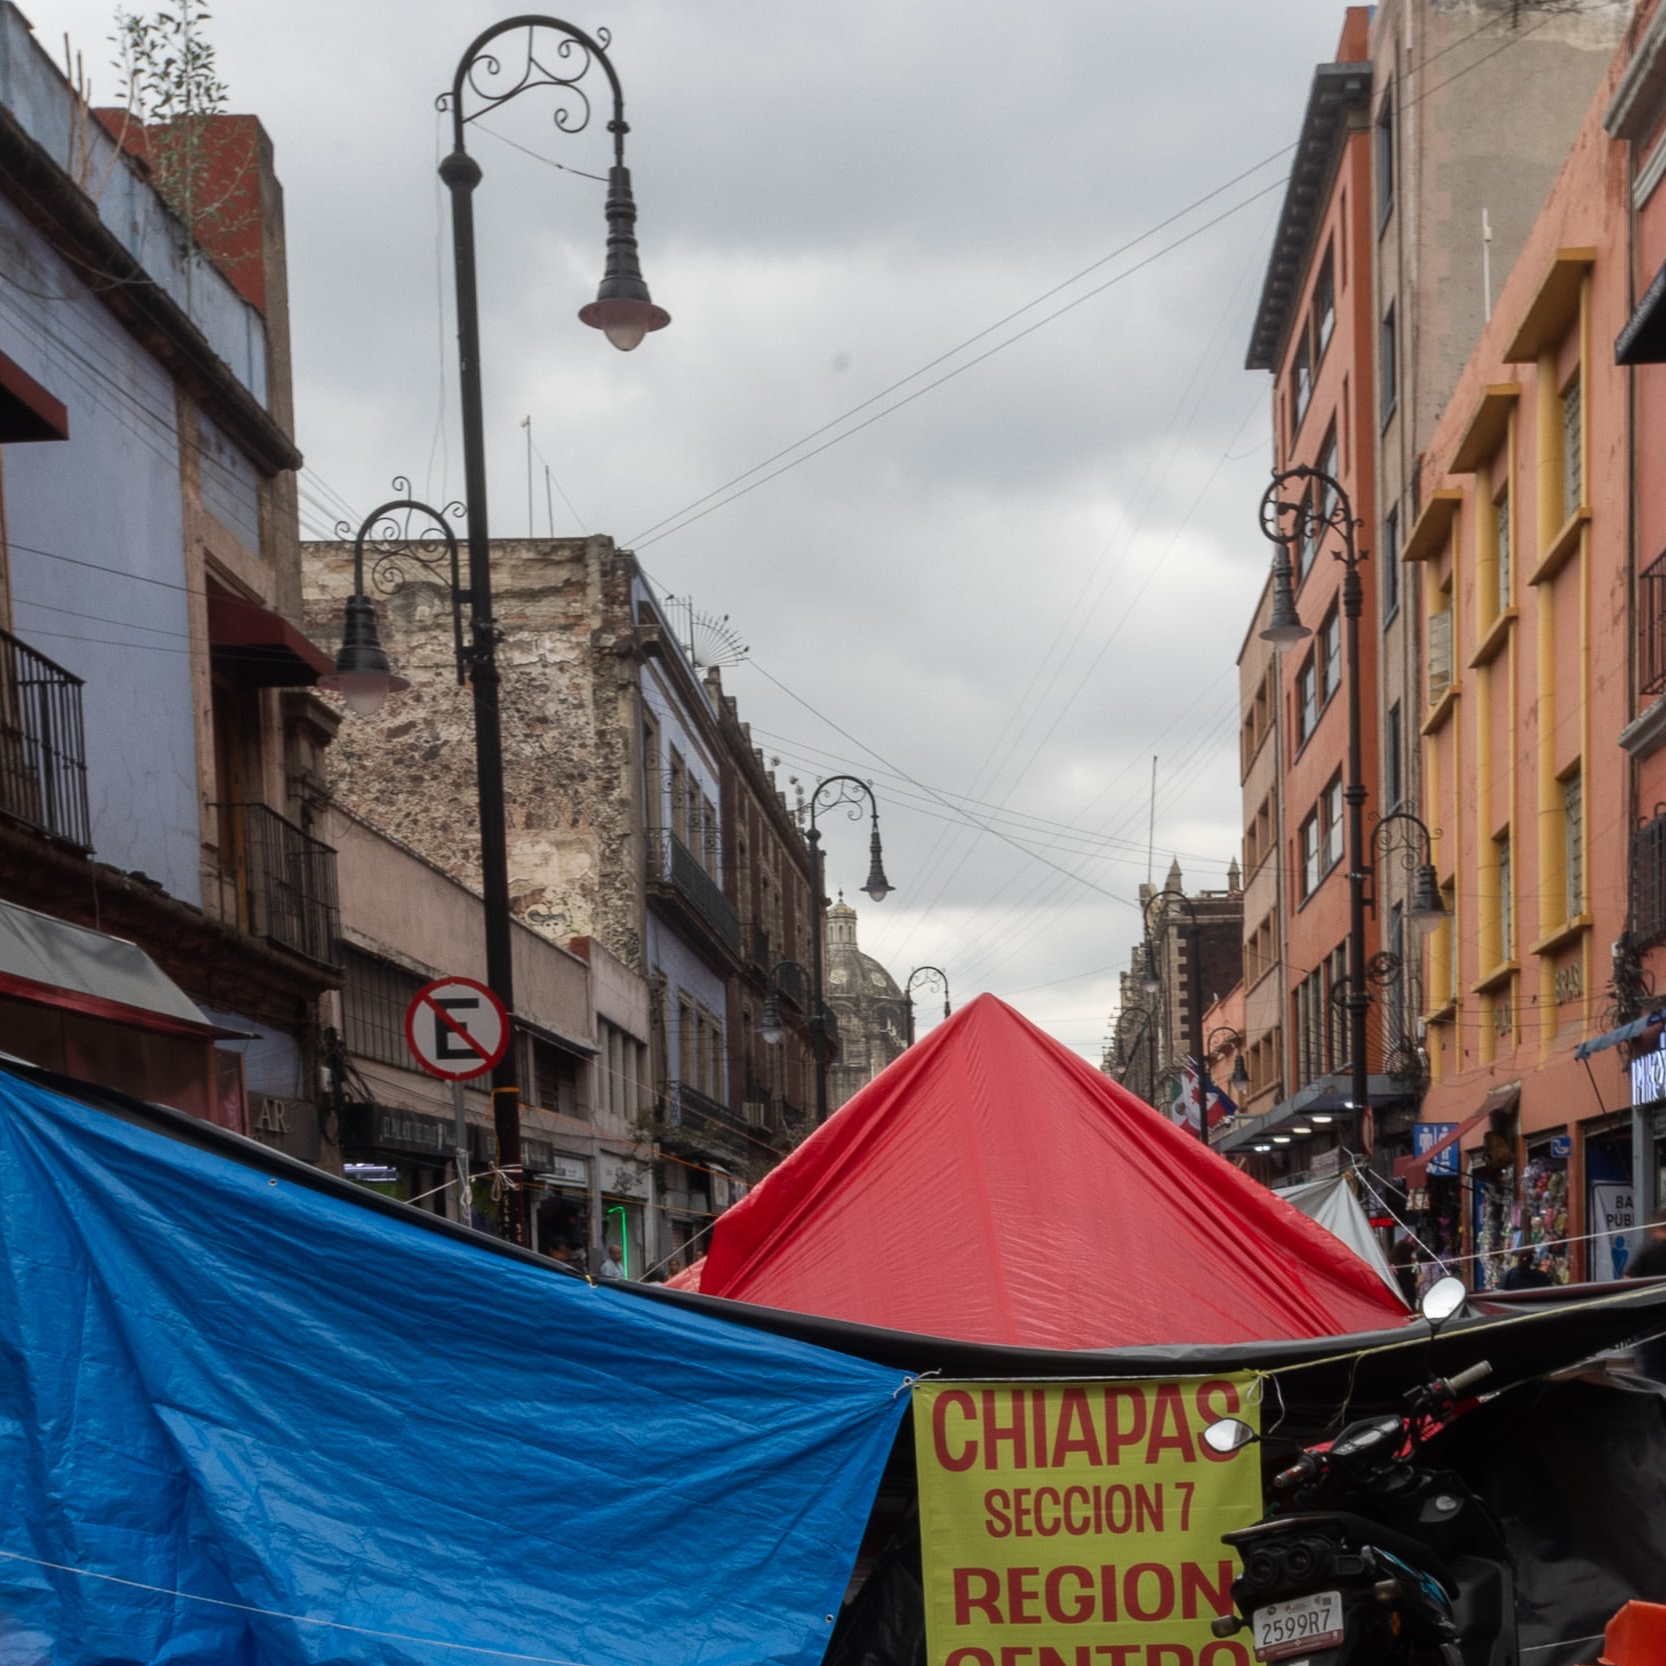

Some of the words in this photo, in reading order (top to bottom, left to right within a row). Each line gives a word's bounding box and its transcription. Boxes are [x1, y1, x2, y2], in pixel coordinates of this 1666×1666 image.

[932, 1380, 1240, 1473] CHIAPAS
[984, 1483, 1165, 1539] SECCION
[1174, 1481, 1196, 1532] 7
[952, 1559, 1234, 1626] REGION
[1261, 1607, 1331, 1646] 2599R7
